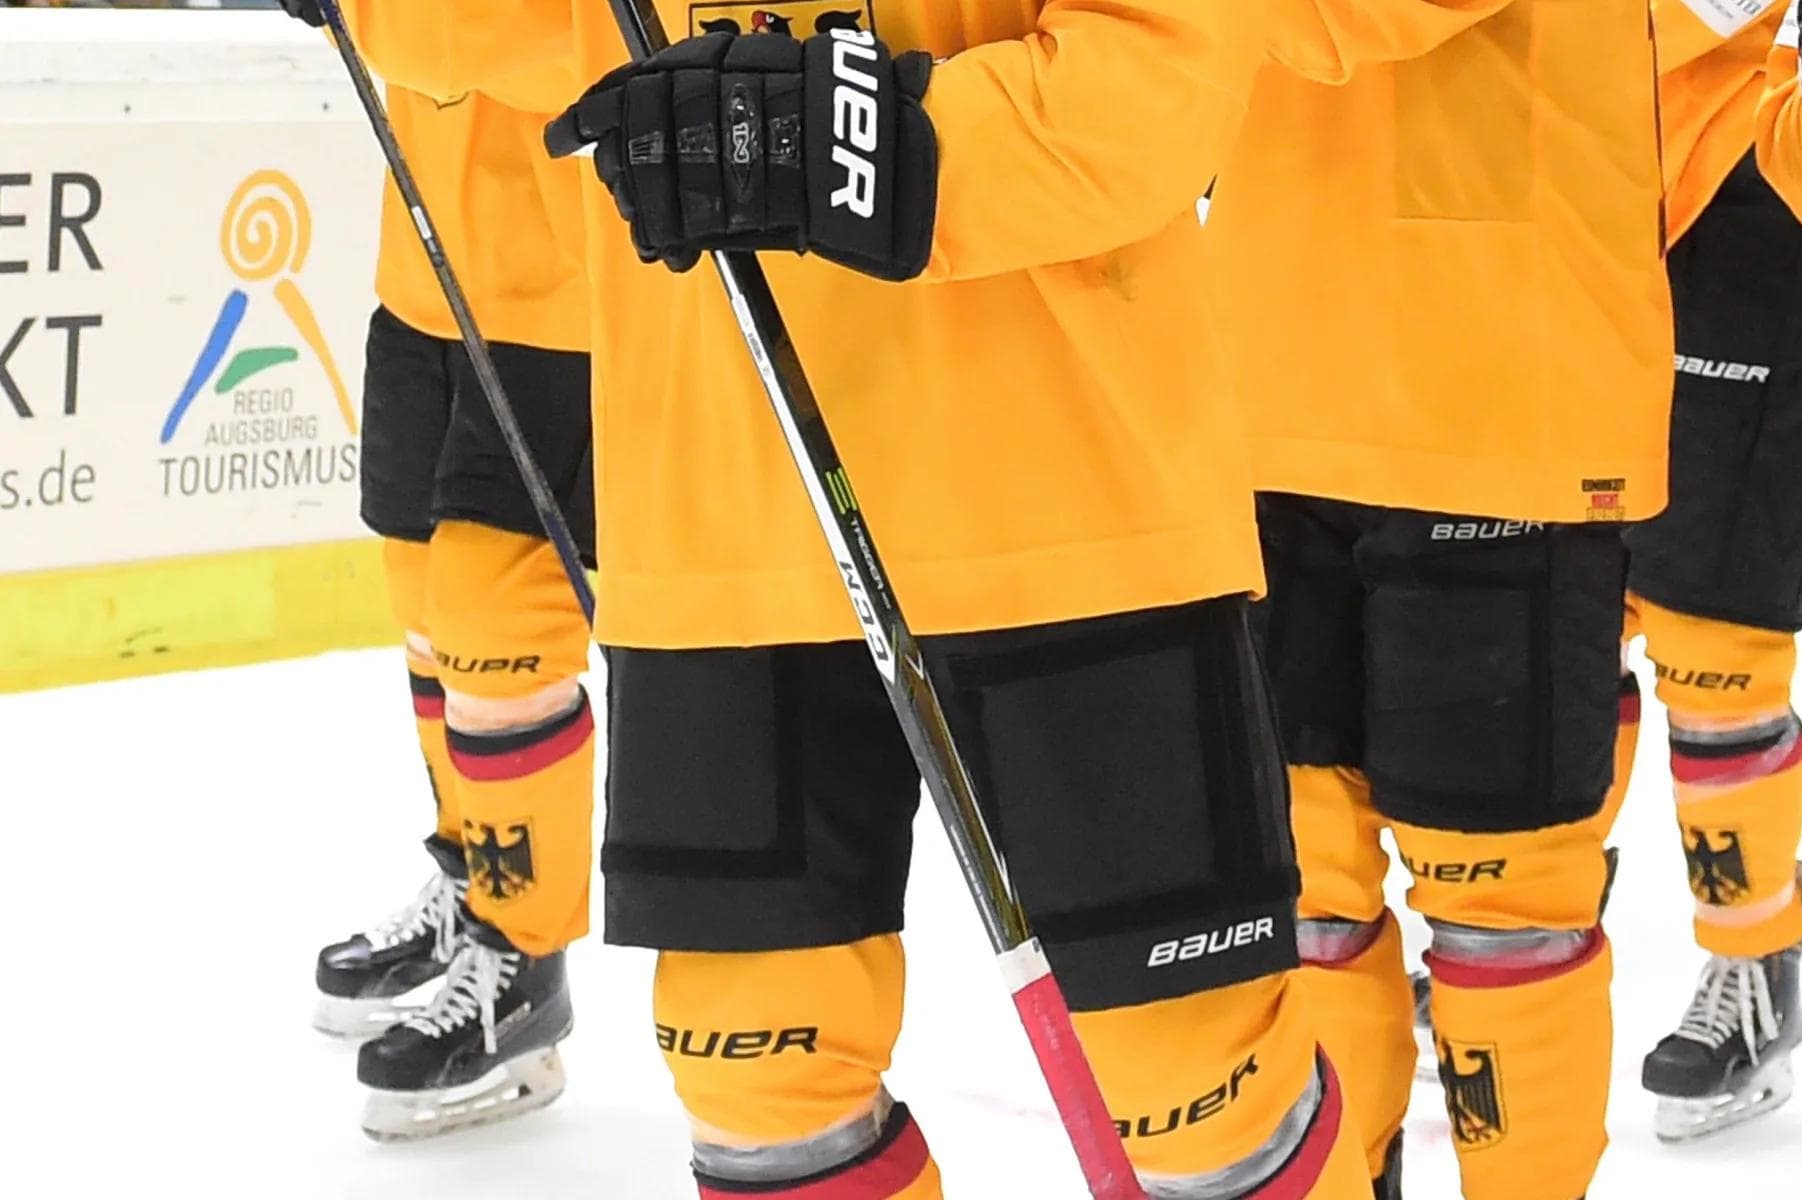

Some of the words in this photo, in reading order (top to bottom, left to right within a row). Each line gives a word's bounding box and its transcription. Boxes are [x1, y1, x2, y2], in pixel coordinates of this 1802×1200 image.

[233, 386, 294, 415] REGIO
[205, 415, 319, 448] AUGSBURG
[158, 443, 358, 498] TOURISMUS
[838, 559, 891, 663] CCM
